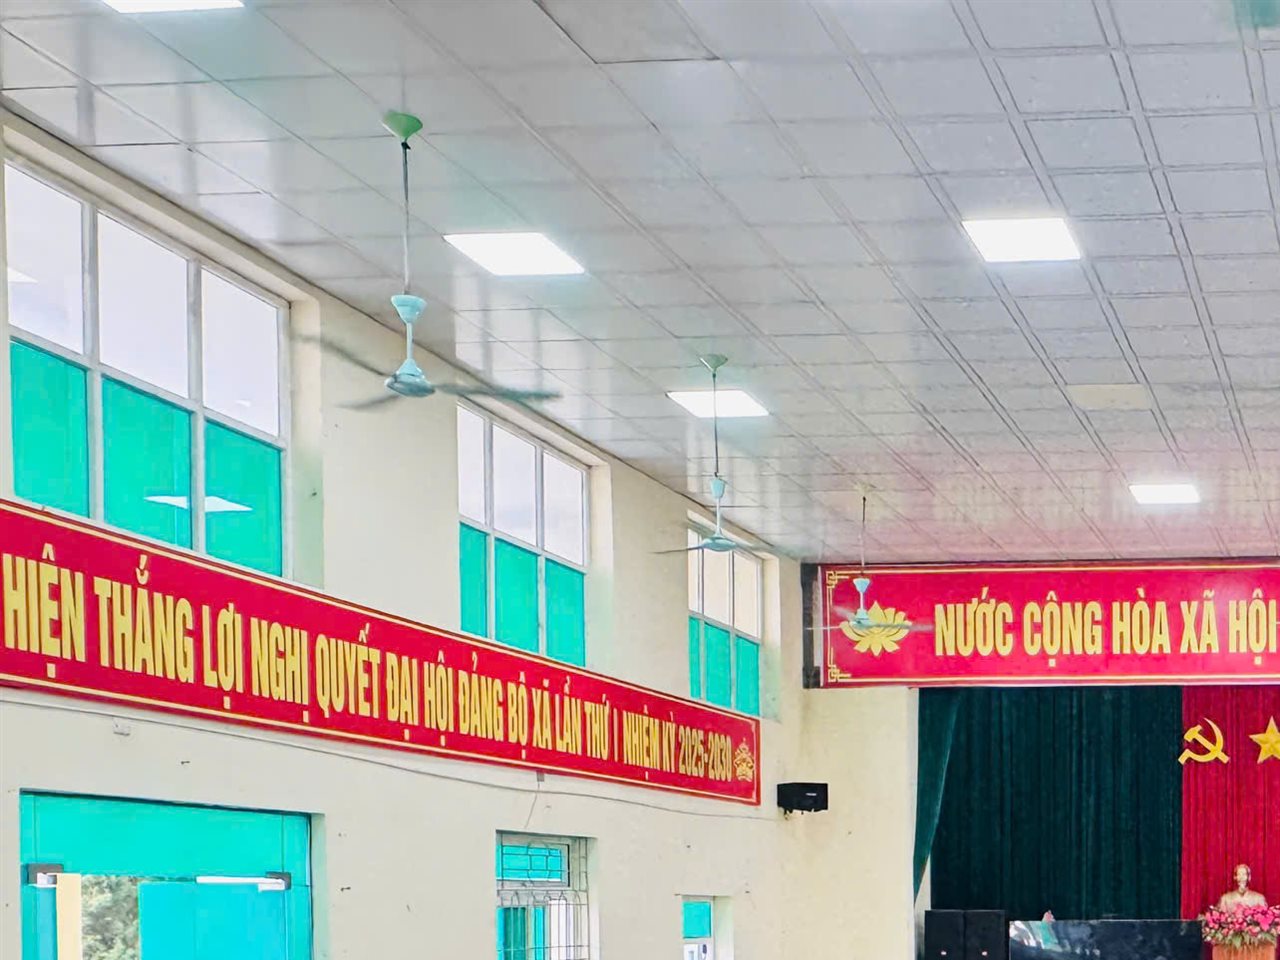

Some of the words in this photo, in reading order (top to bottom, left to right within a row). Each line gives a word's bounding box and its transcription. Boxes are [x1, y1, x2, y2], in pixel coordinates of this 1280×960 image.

[2, 543, 85, 678] HIỆN
[94, 555, 194, 683] THẮNG
[202, 603, 243, 709] LỢI
[250, 617, 309, 722] NGHỊ
[315, 623, 380, 718] QUYẾT
[386, 652, 418, 740] ĐẠI
[424, 650, 454, 746] HỘI
[459, 651, 504, 742] ĐẢNG
[507, 671, 528, 759] BỘ
[532, 679, 552, 750] XÃ
[584, 693, 609, 760] THỨ
[623, 704, 660, 780] NHIỆM
[662, 711, 675, 773] KỲ
[679, 725, 732, 782] 2025-2030
[935, 587, 1013, 656] NƯỚC
[1023, 590, 1102, 667] CỘNG
[1113, 588, 1171, 654] HÒA
[1180, 589, 1219, 654] XÃ
[1229, 588, 1276, 666] HỘI
